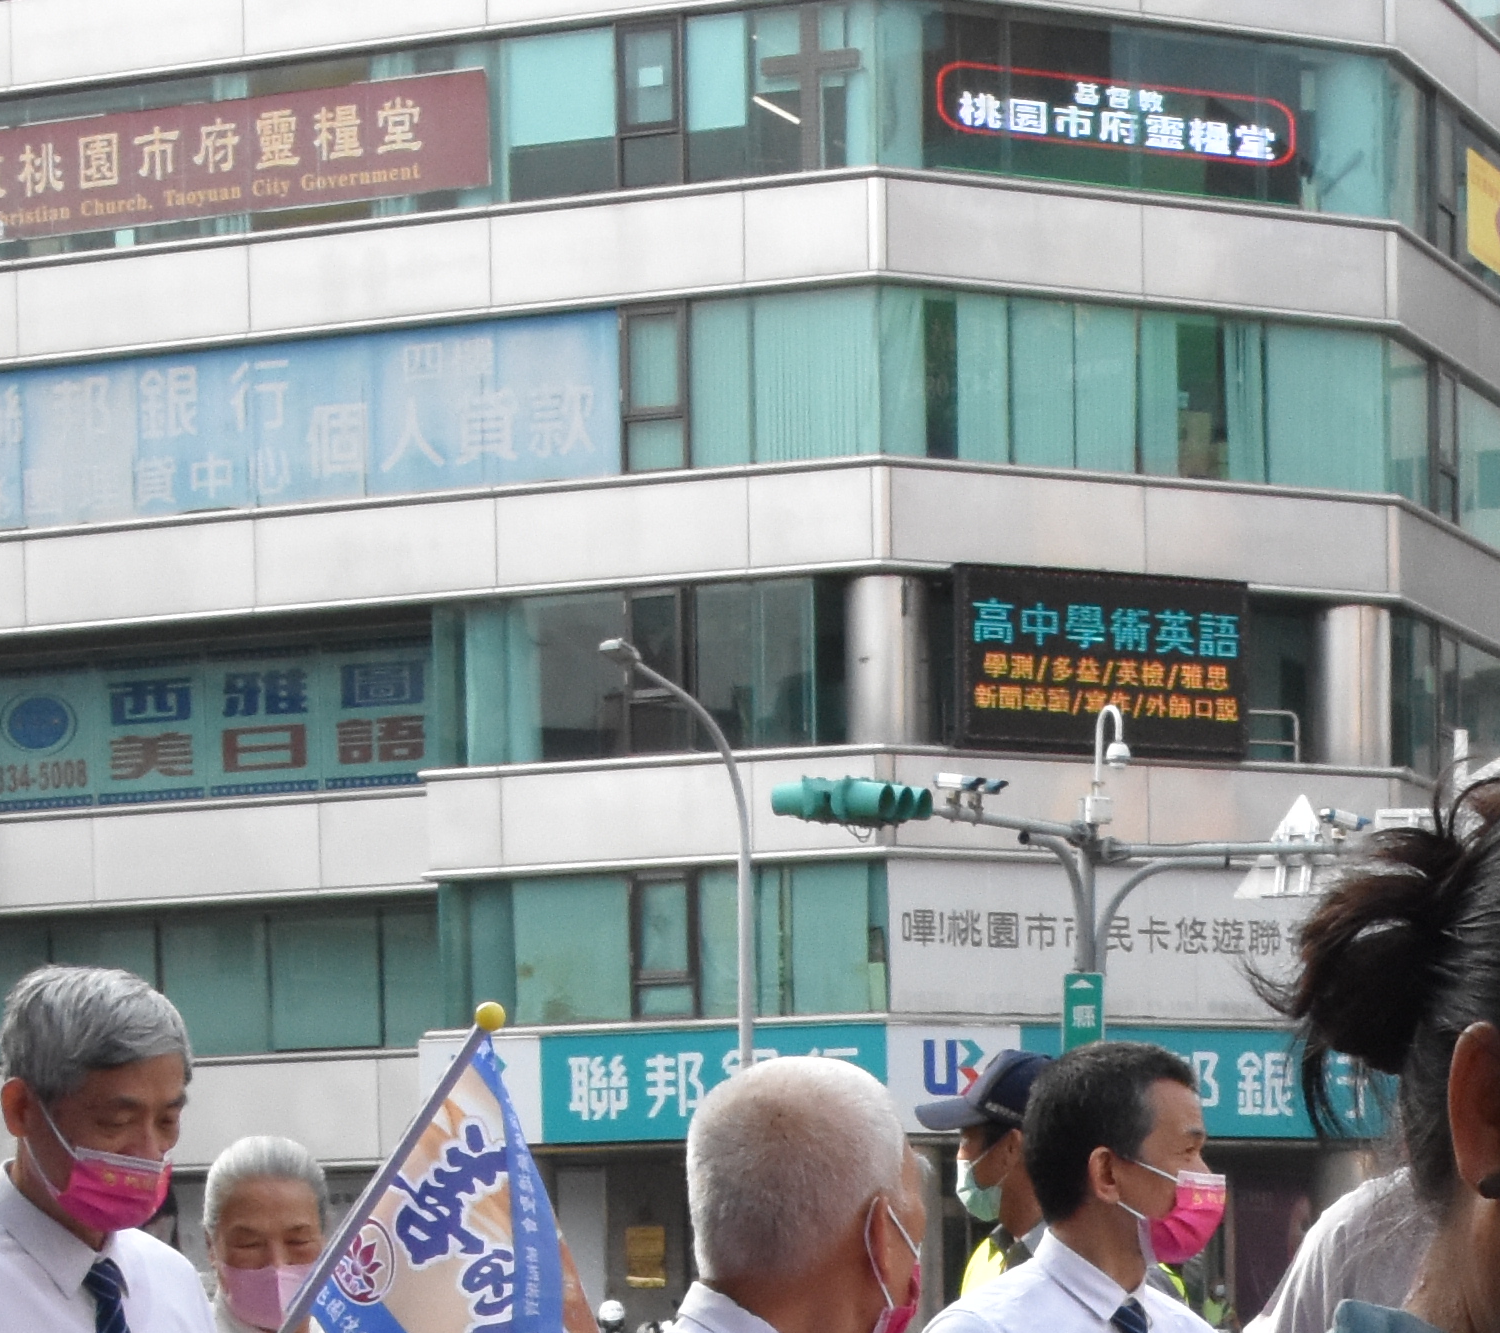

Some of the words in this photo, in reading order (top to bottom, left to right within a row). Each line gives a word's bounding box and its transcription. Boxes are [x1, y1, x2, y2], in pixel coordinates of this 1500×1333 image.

[1075, 82, 1163, 112] 基督教
[163, 186, 241, 208] Taoyuan
[252, 177, 290, 198] City
[301, 162, 421, 191] Government
[972, 597, 1239, 658] 高中學術英語
[107, 659, 424, 726] 西雅圖
[111, 714, 425, 780] 美日語
[568, 1047, 858, 1120] 聯邦
